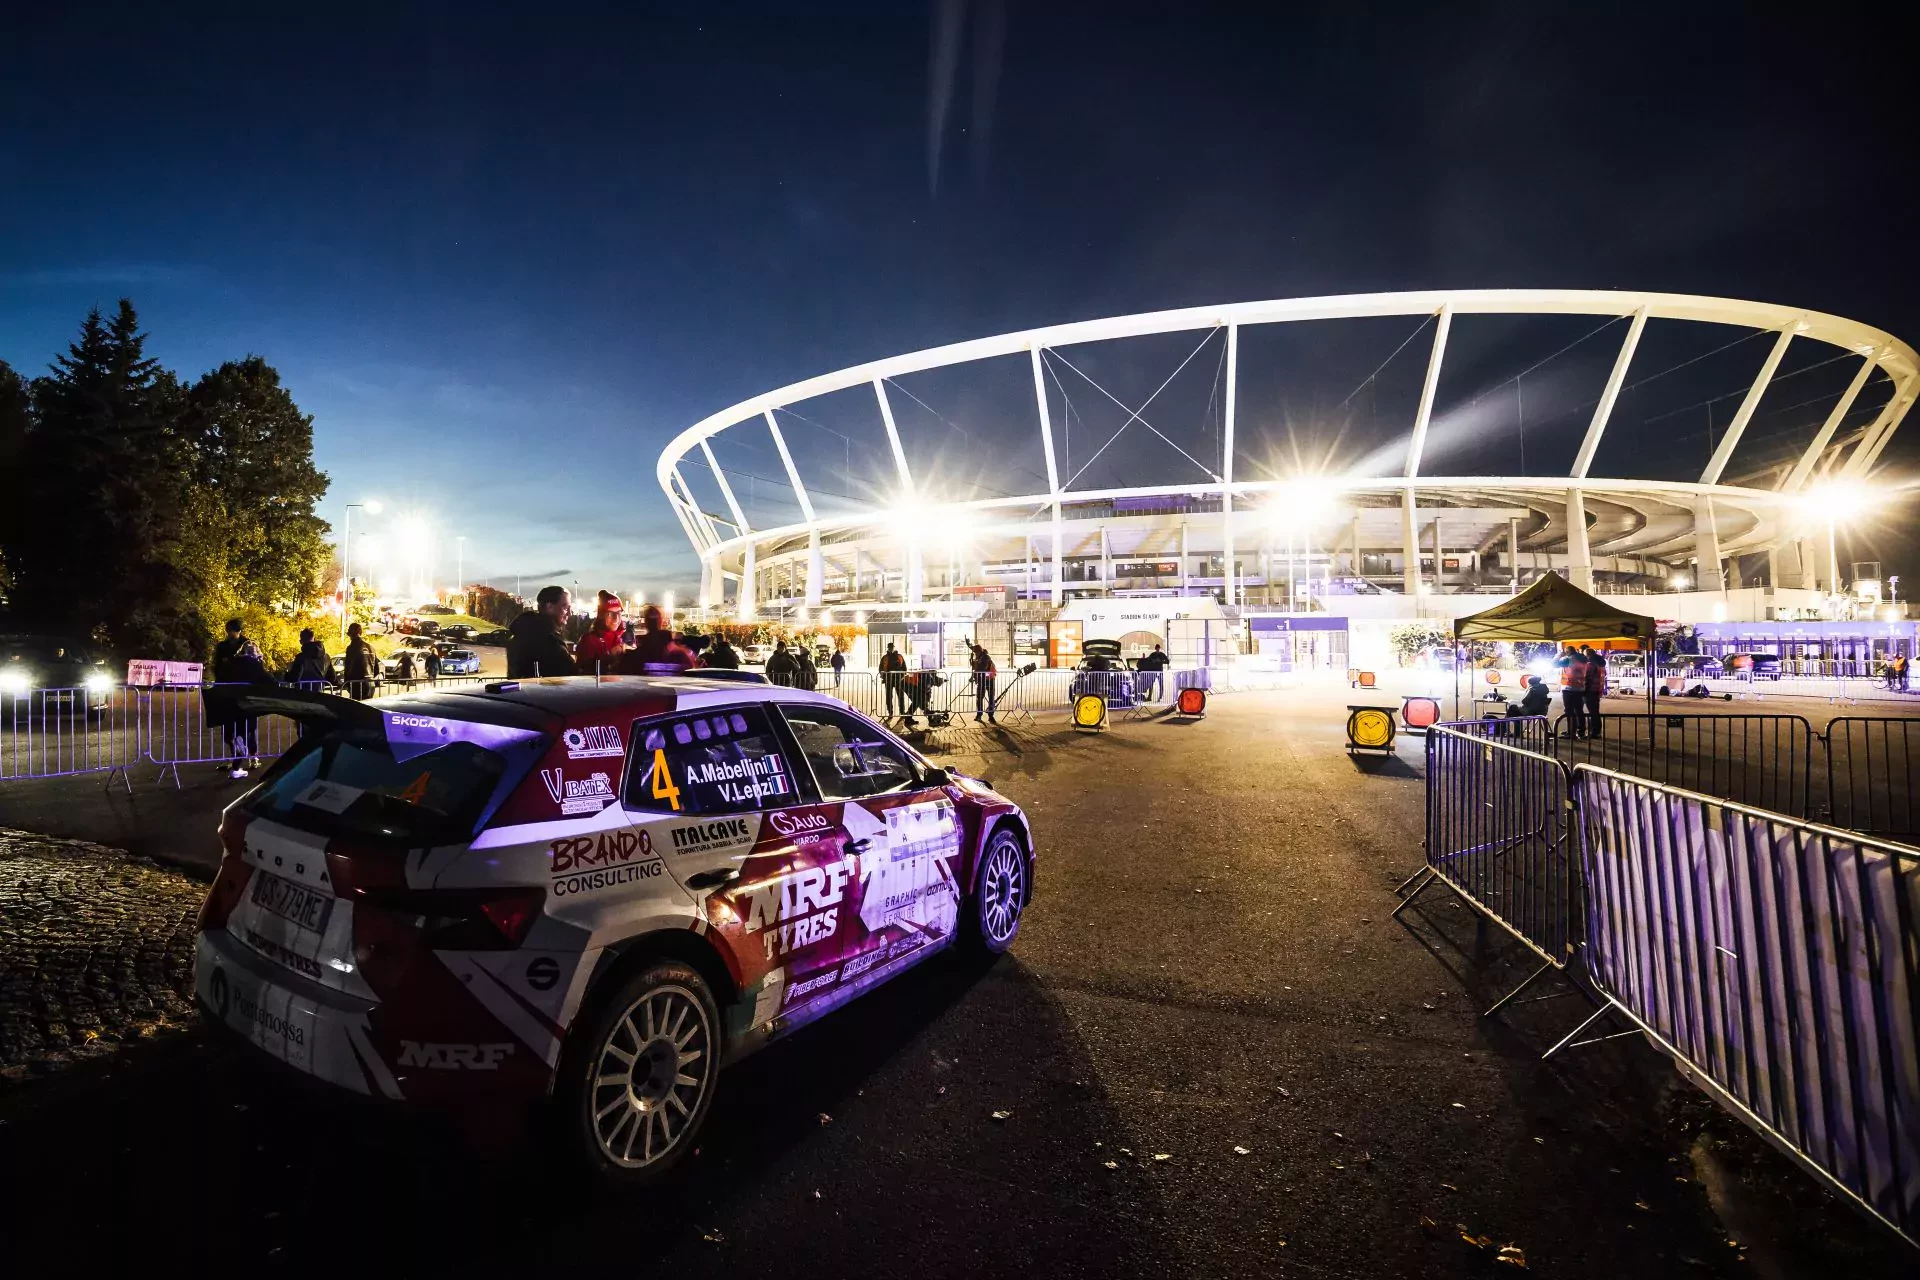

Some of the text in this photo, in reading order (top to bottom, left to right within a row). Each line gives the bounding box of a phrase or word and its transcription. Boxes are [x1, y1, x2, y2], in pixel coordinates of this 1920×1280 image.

[652, 748, 680, 810] 4
[687, 756, 769, 785] A.Mabellini
[671, 819, 750, 848] ITALCAVE
[793, 834, 820, 846] NIARDO
[551, 829, 653, 872] BRANDO
[677, 843, 712, 856] FORNITURA
[553, 862, 663, 897] CONSULTING
[744, 860, 855, 935] MRF
[885, 888, 918, 908] GRAPHIC
[764, 908, 838, 961] TYRES
[397, 1040, 515, 1070] MRF
